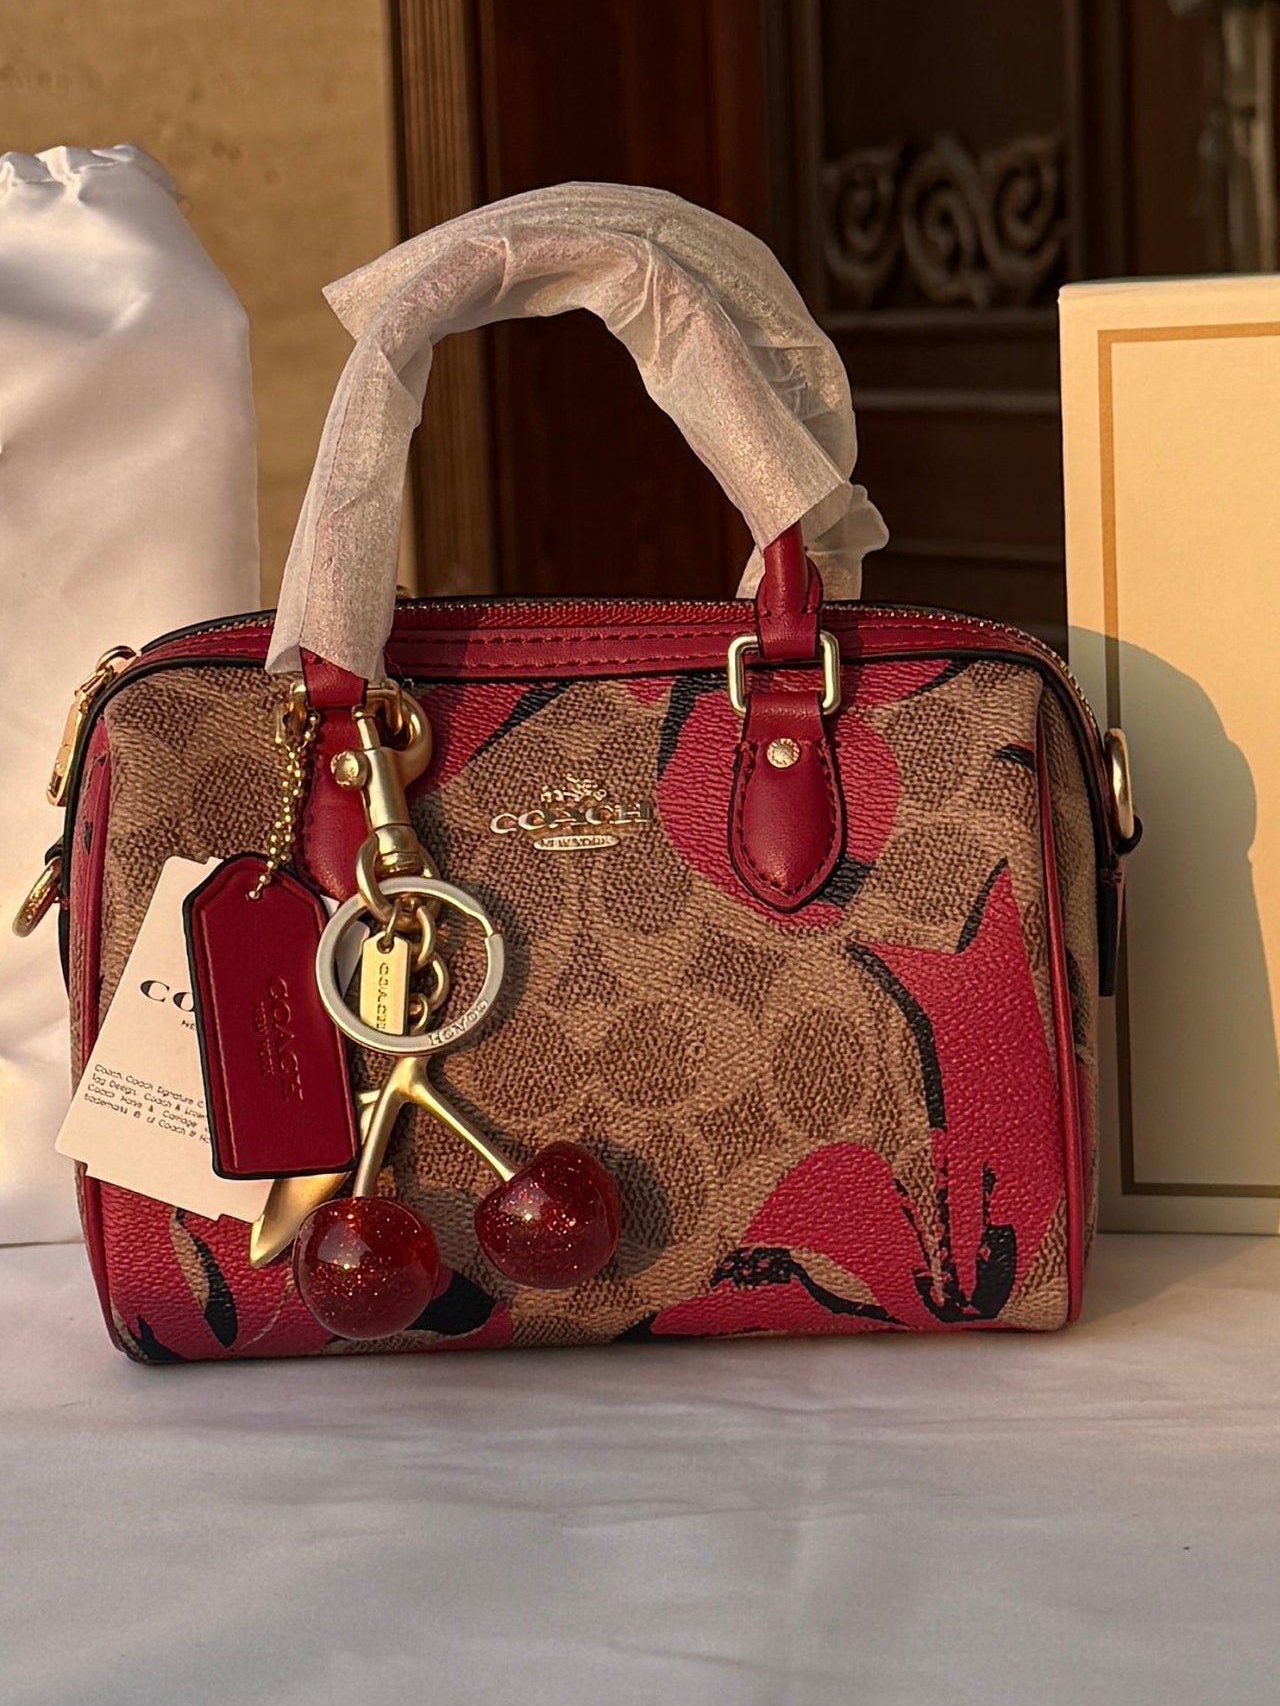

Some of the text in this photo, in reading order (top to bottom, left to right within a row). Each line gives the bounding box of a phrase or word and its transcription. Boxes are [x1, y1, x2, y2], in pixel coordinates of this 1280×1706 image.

[489, 803, 655, 834] COACH
[376, 962, 389, 1031] COACH
[270, 975, 304, 1102] COACH
